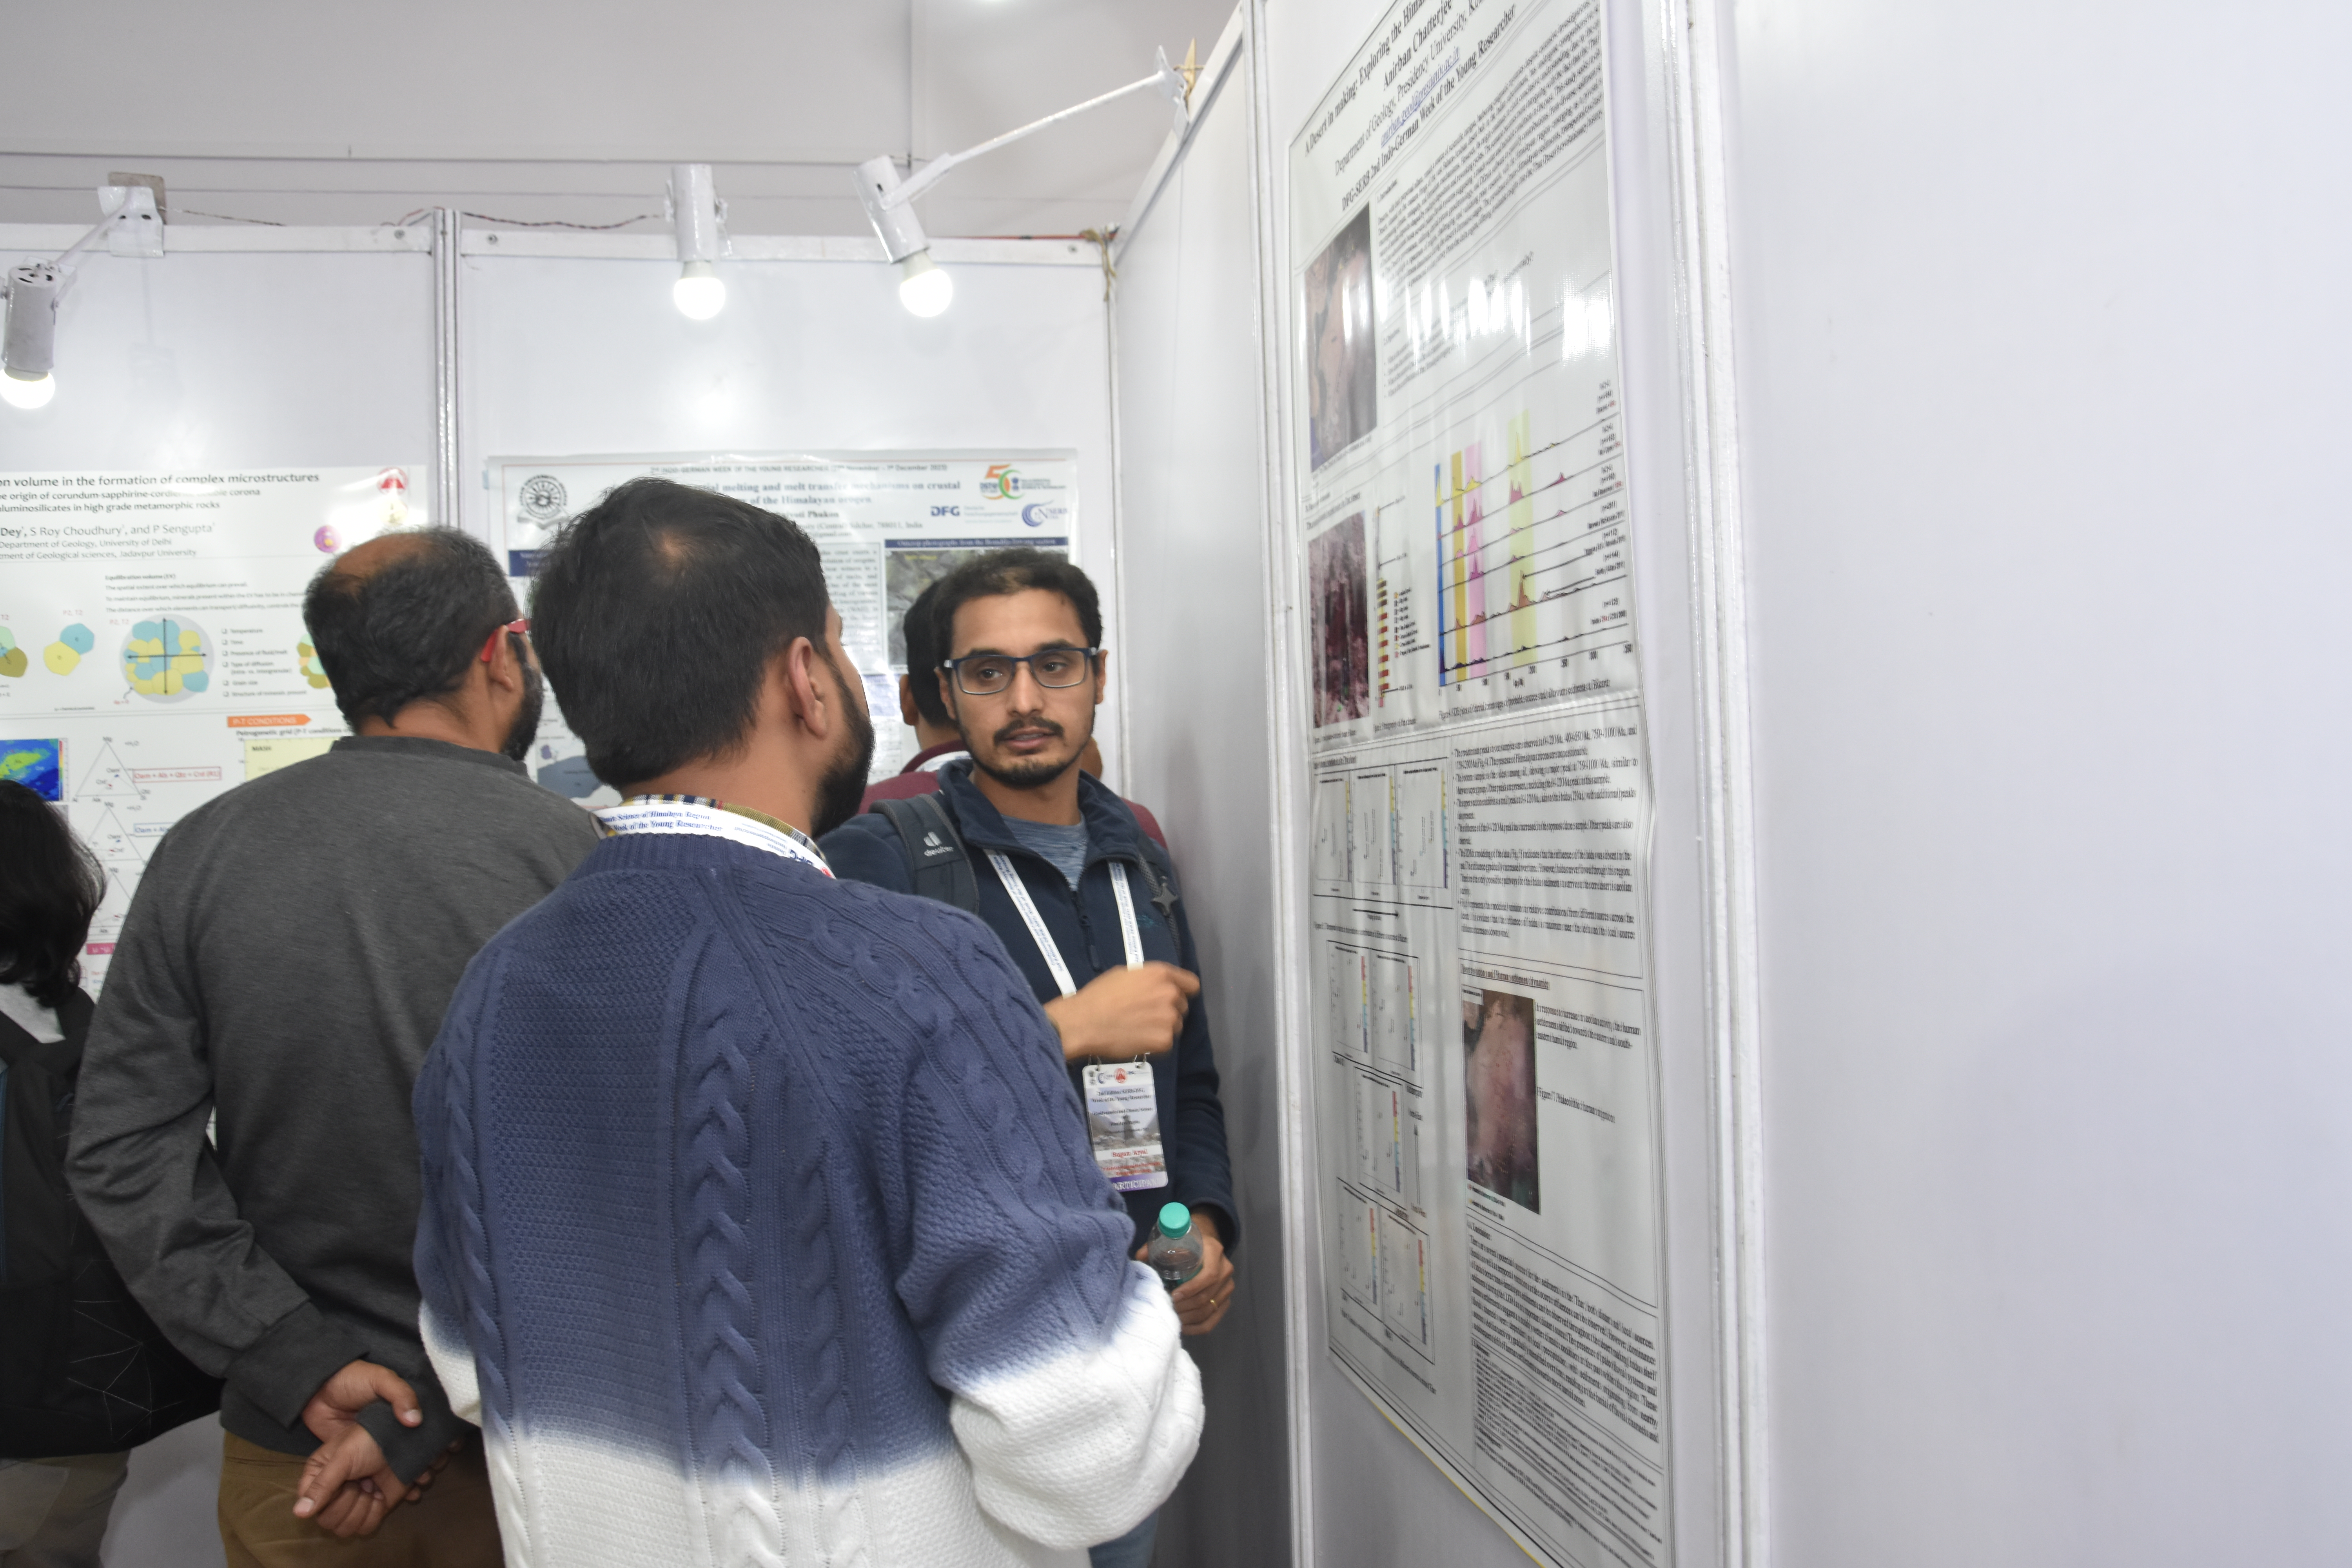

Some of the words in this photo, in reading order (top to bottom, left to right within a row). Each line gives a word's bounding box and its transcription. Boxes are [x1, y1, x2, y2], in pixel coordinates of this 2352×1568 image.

[1384, 47, 1411, 90] Anirban
[1413, 0, 1452, 52] Chatterjee
[1305, 142, 1309, 156] A
[1310, 118, 1326, 150] Desert
[1328, 111, 1333, 126] in
[1335, 80, 1357, 117] making:
[1359, 37, 1389, 85] Exploring
[1391, 21, 1401, 43] the
[1335, 134, 1364, 176] Department
[1365, 120, 1371, 141] of
[1372, 97, 1396, 131] Geology,
[1397, 55, 1428, 101] Presidency
[1430, 11, 1466, 60] University,
[1342, 170, 1369, 210] DFG-SERB
[1371, 157, 1379, 179] 2nd
[1381, 119, 1418, 166] Indo-German
[1420, 96, 1434, 121] Week
[1436, 84, 1443, 104] of
[1444, 77, 1454, 96] the
[1456, 52, 1476, 81] Young
[1478, 5, 1514, 57] Researcher
[15, 476, 58, 487] volume
[62, 477, 73, 486] in
[76, 476, 95, 486] the
[99, 475, 157, 486] formation
[160, 475, 173, 484] of
[176, 474, 225, 485] complex
[228, 473, 319, 483] microstructures
[722, 483, 759, 492] melting
[762, 483, 781, 491] and
[784, 482, 805, 491] melt
[927, 481, 961, 490] crustal
[10, 492, 37, 502] origin
[40, 491, 50, 500] of
[782, 495, 835, 505] Himalayan
[0, 503, 71, 512] luminosilicates
[84, 503, 104, 514] high
[106, 503, 132, 513] grade
[134, 501, 194, 512] metamorphic
[930, 505, 960, 517] DFG
[30, 527, 37, 536] S
[40, 527, 60, 538] Roy
[130, 524, 150, 535] and
[153, 525, 160, 534] P
[62, 539, 98, 550] Geology,
[100, 539, 140, 549] University
[25, 551, 34, 559] of
[36, 550, 79, 561] Geological
[81, 550, 117, 560] sciences,
[119, 549, 155, 559] Jadavpur
[157, 548, 197, 558] University
[685, 811, 711, 820] Region
[650, 820, 674, 829] Young
[676, 820, 724, 832] Researcher
[1112, 1178, 1161, 1190] ARTICIPAN
